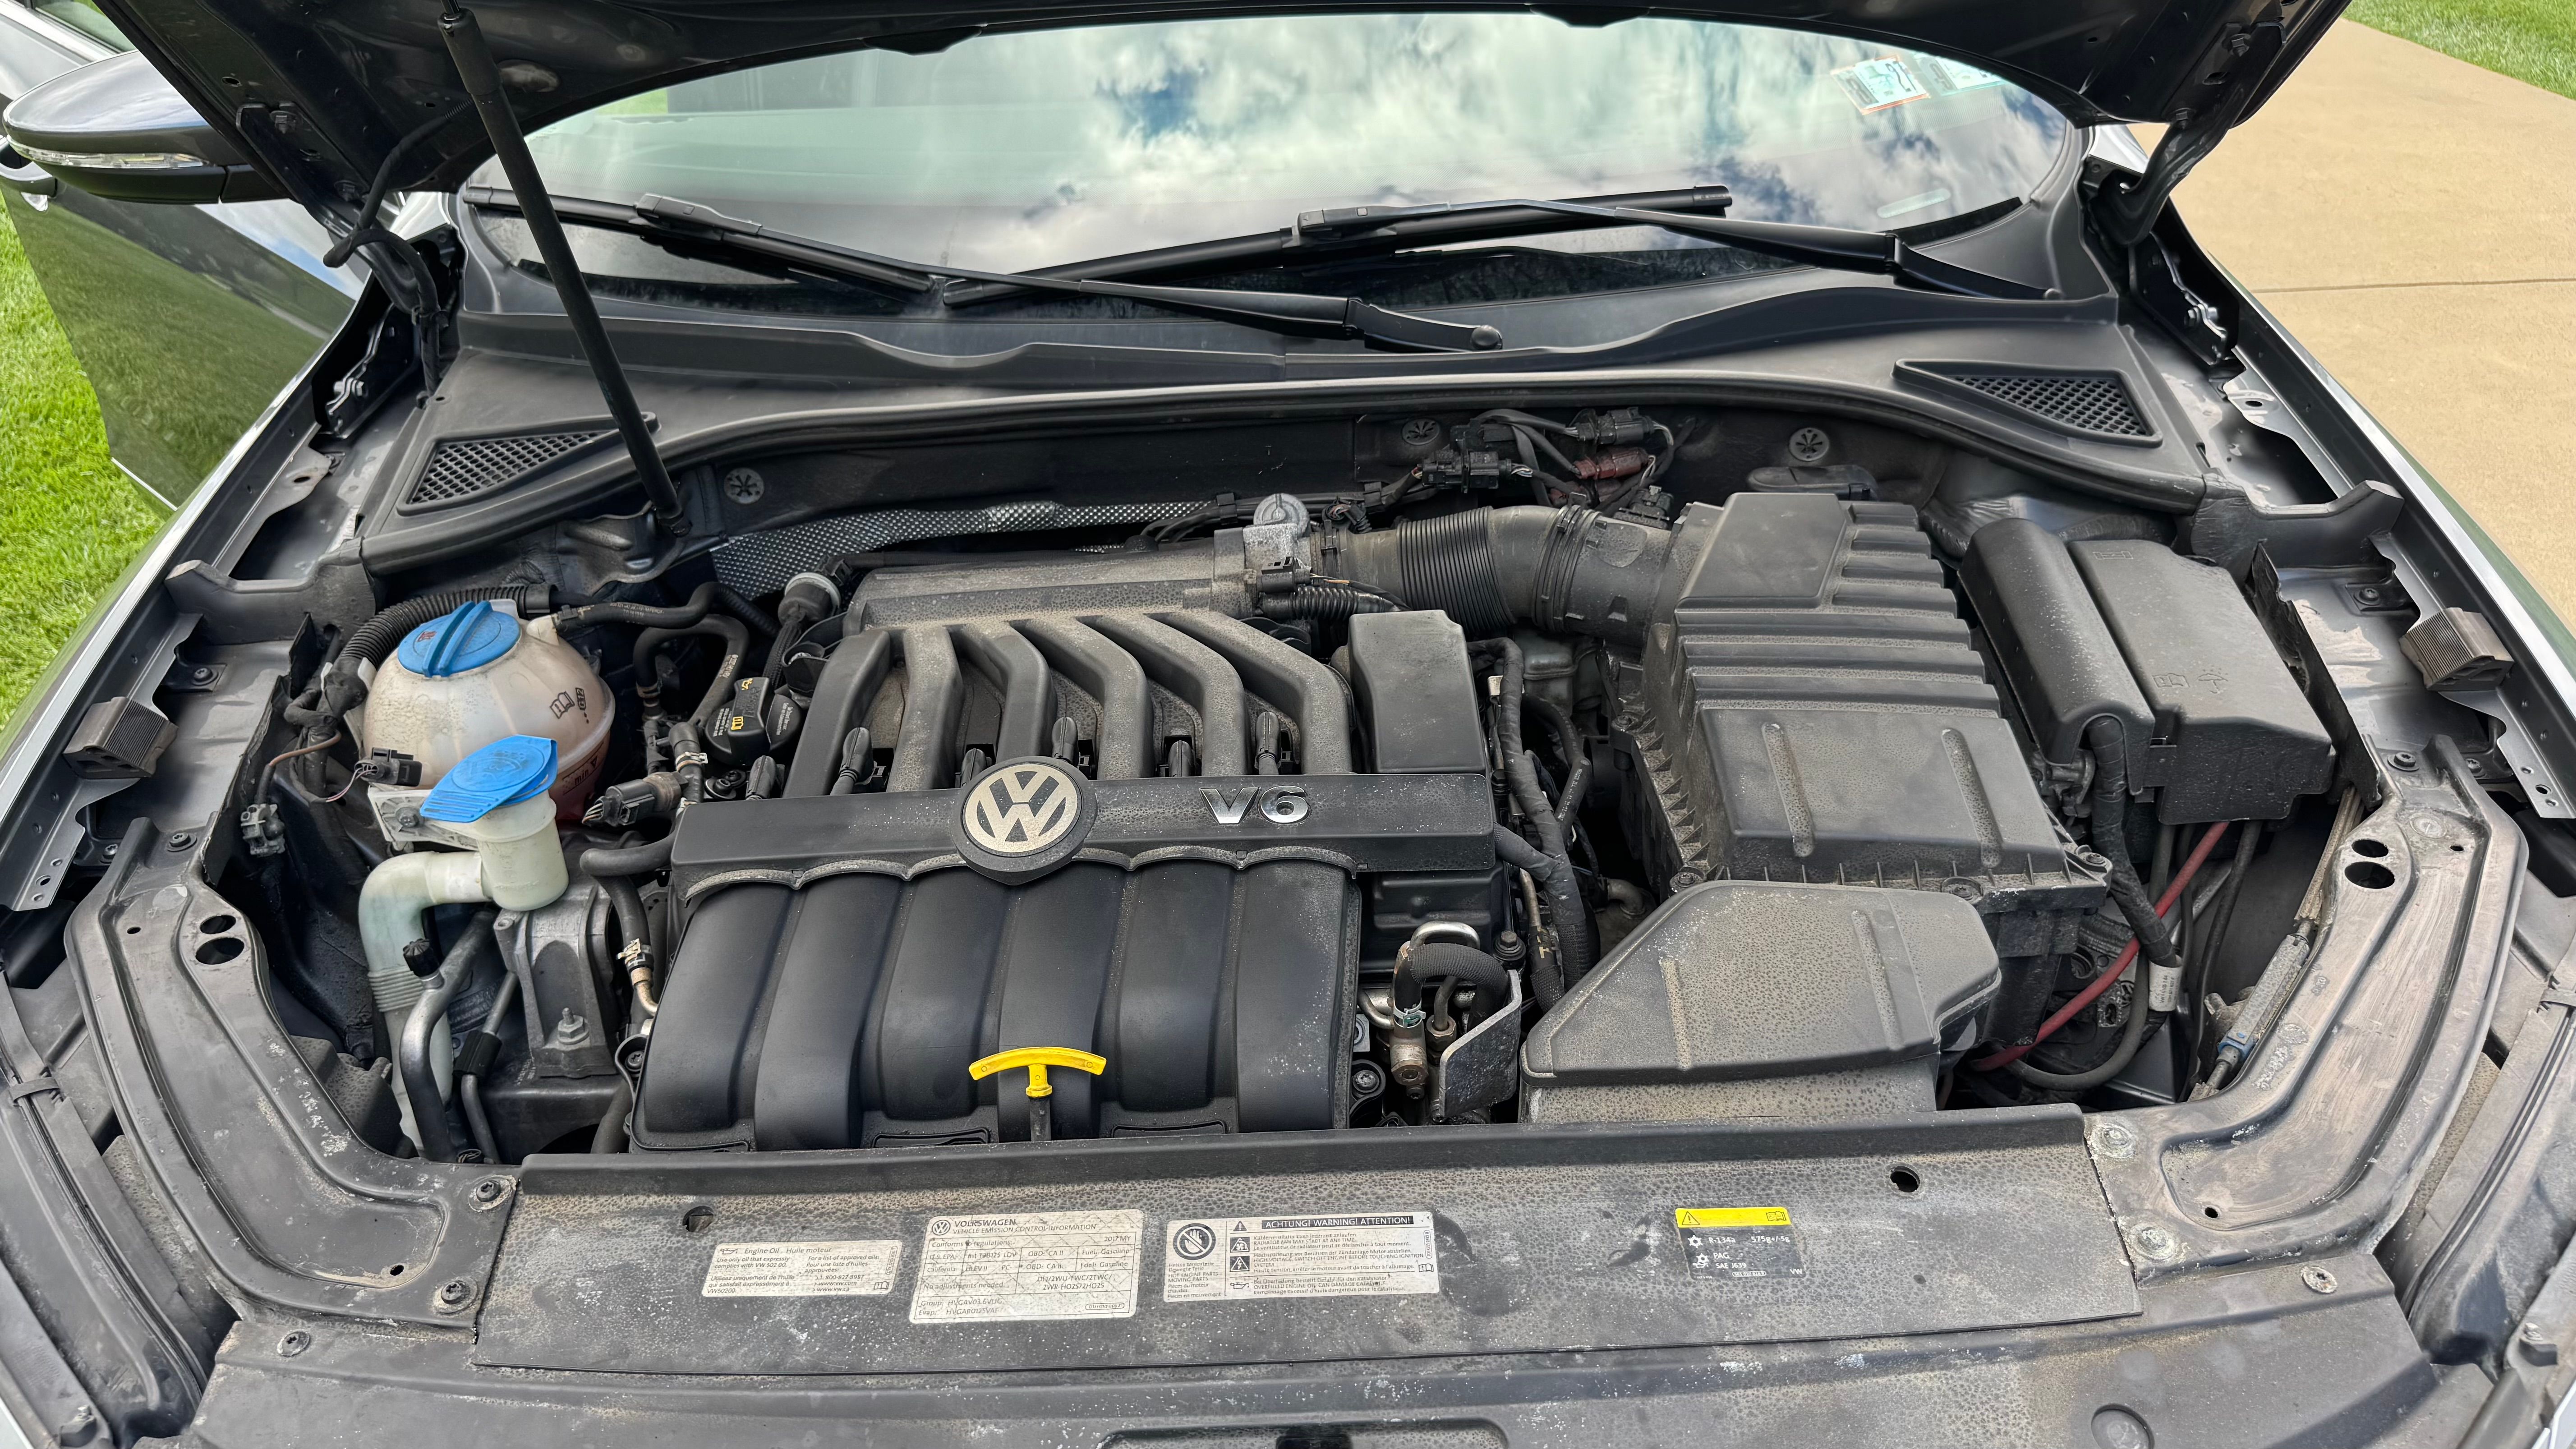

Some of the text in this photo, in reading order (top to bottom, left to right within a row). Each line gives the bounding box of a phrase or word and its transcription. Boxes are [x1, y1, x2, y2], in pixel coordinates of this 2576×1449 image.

[577, 688, 585, 708] G12
[575, 769, 589, 786] min
[1199, 785, 1311, 824] V6
[955, 1219, 1016, 1227] VOLKSWAGEN
